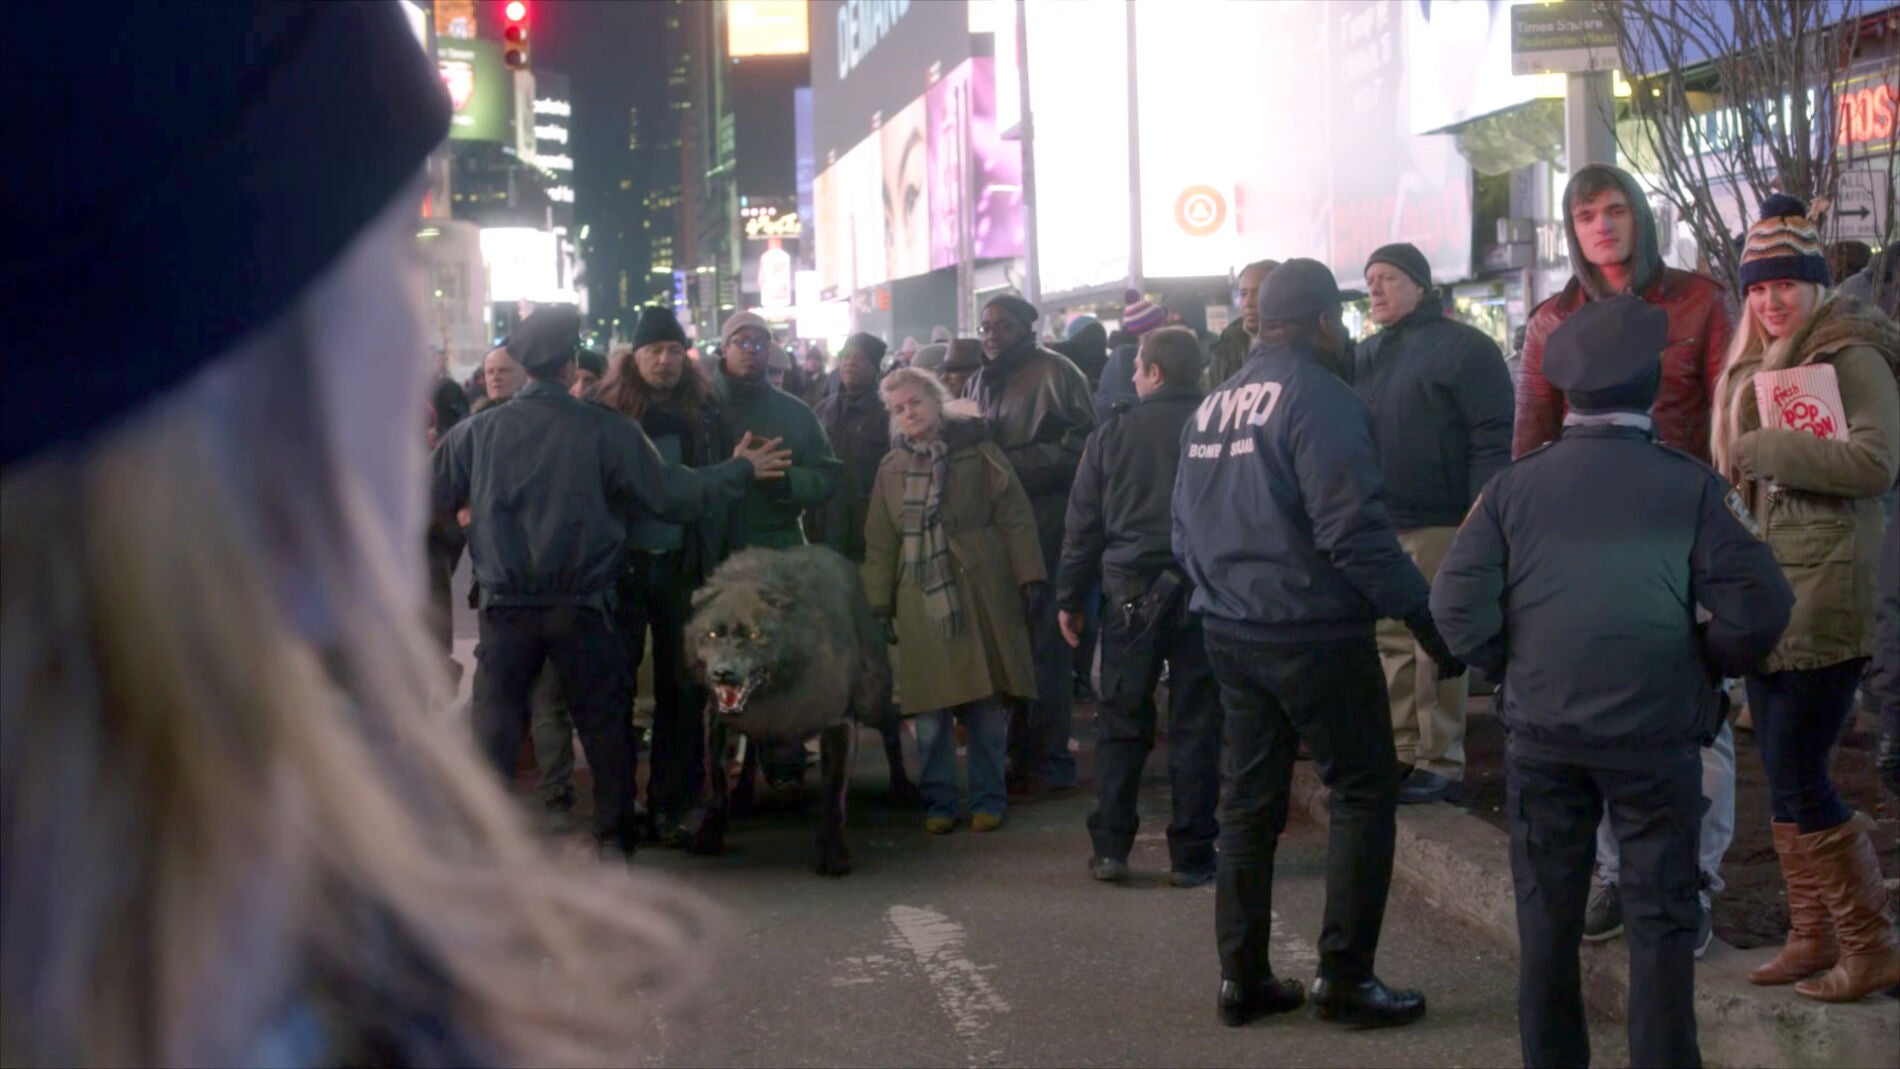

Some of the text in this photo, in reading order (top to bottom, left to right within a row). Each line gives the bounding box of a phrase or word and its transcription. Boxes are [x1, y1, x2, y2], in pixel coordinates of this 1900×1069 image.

[1516, 18, 1604, 33] Times Square
[838, 0, 910, 80] DEMA
[1773, 383, 1800, 408] fresh
[1784, 401, 1819, 428] POP
[1794, 415, 1833, 440] ORN
[1188, 443, 1222, 458] BOMB
